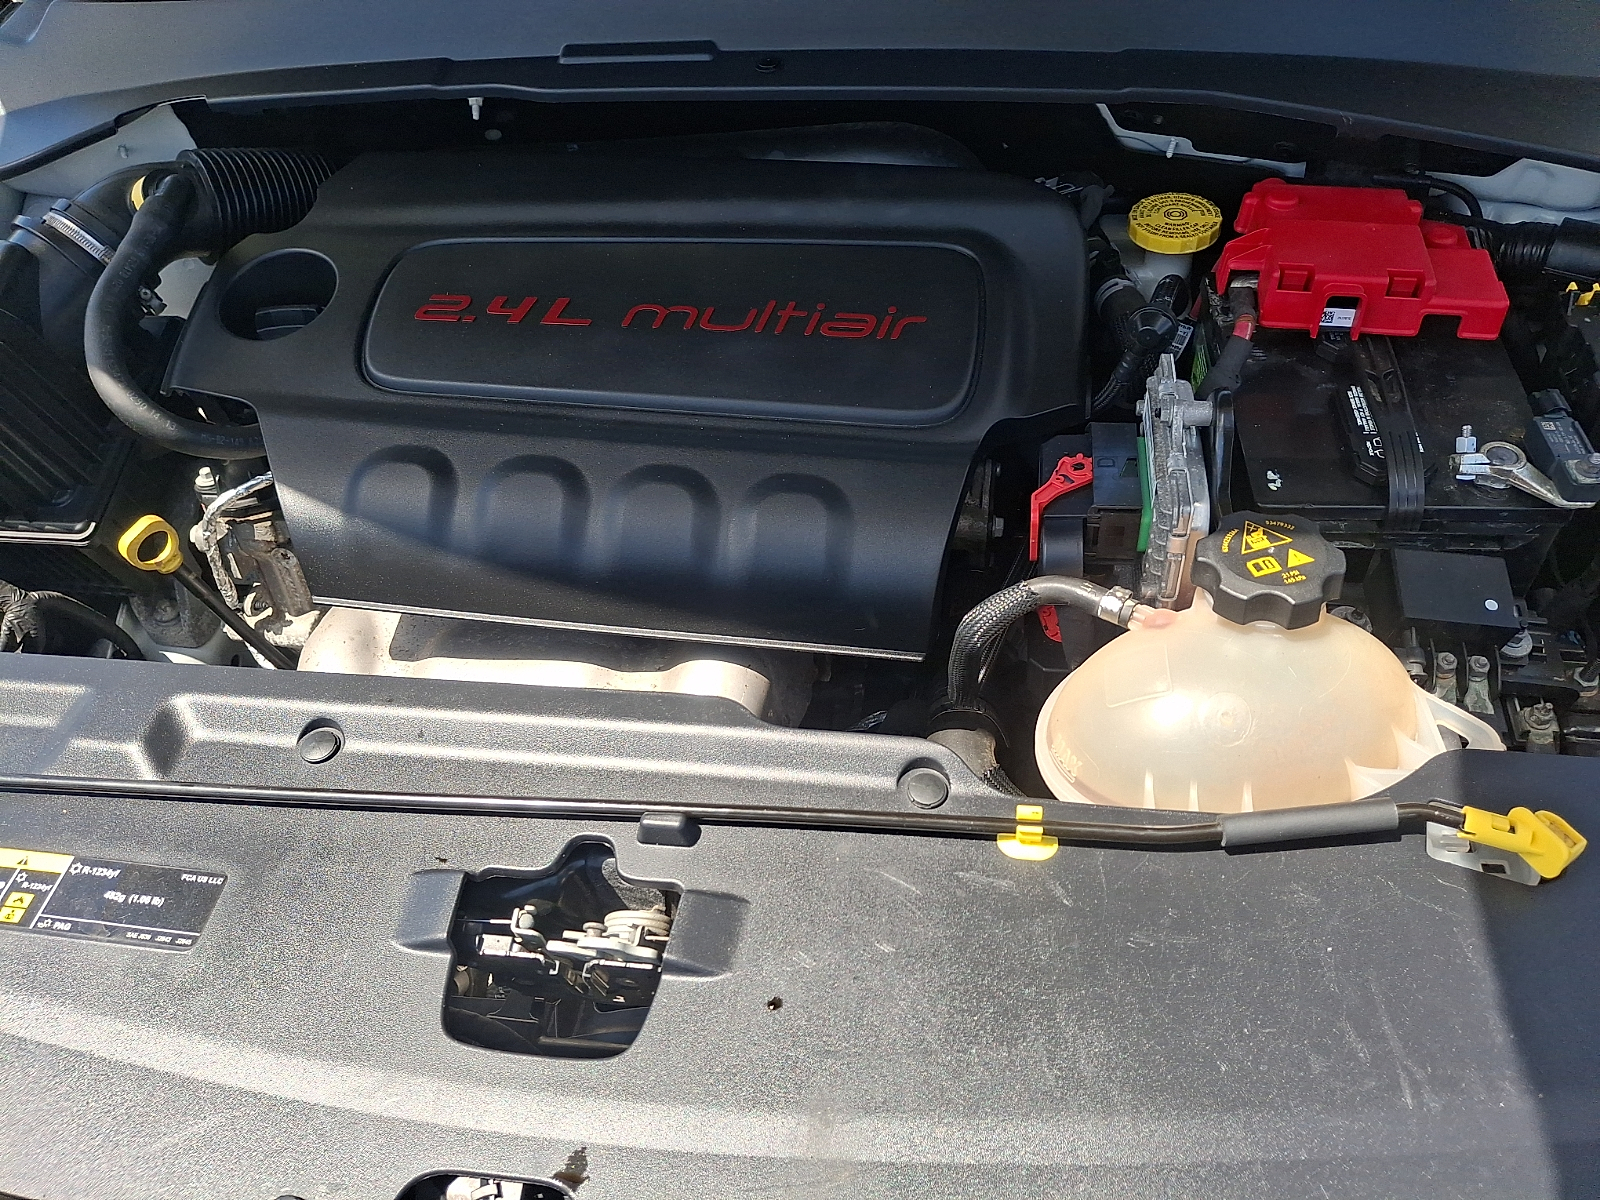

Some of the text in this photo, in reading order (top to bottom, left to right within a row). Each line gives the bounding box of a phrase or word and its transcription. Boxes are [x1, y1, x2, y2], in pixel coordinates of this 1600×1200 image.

[620, 299, 928, 340] multiair
[83, 866, 121, 879] R-1234yf
[181, 873, 197, 882] FCA
[208, 876, 225, 885] LLC
[52, 921, 72, 931] PAG
[125, 931, 139, 939] SAE
